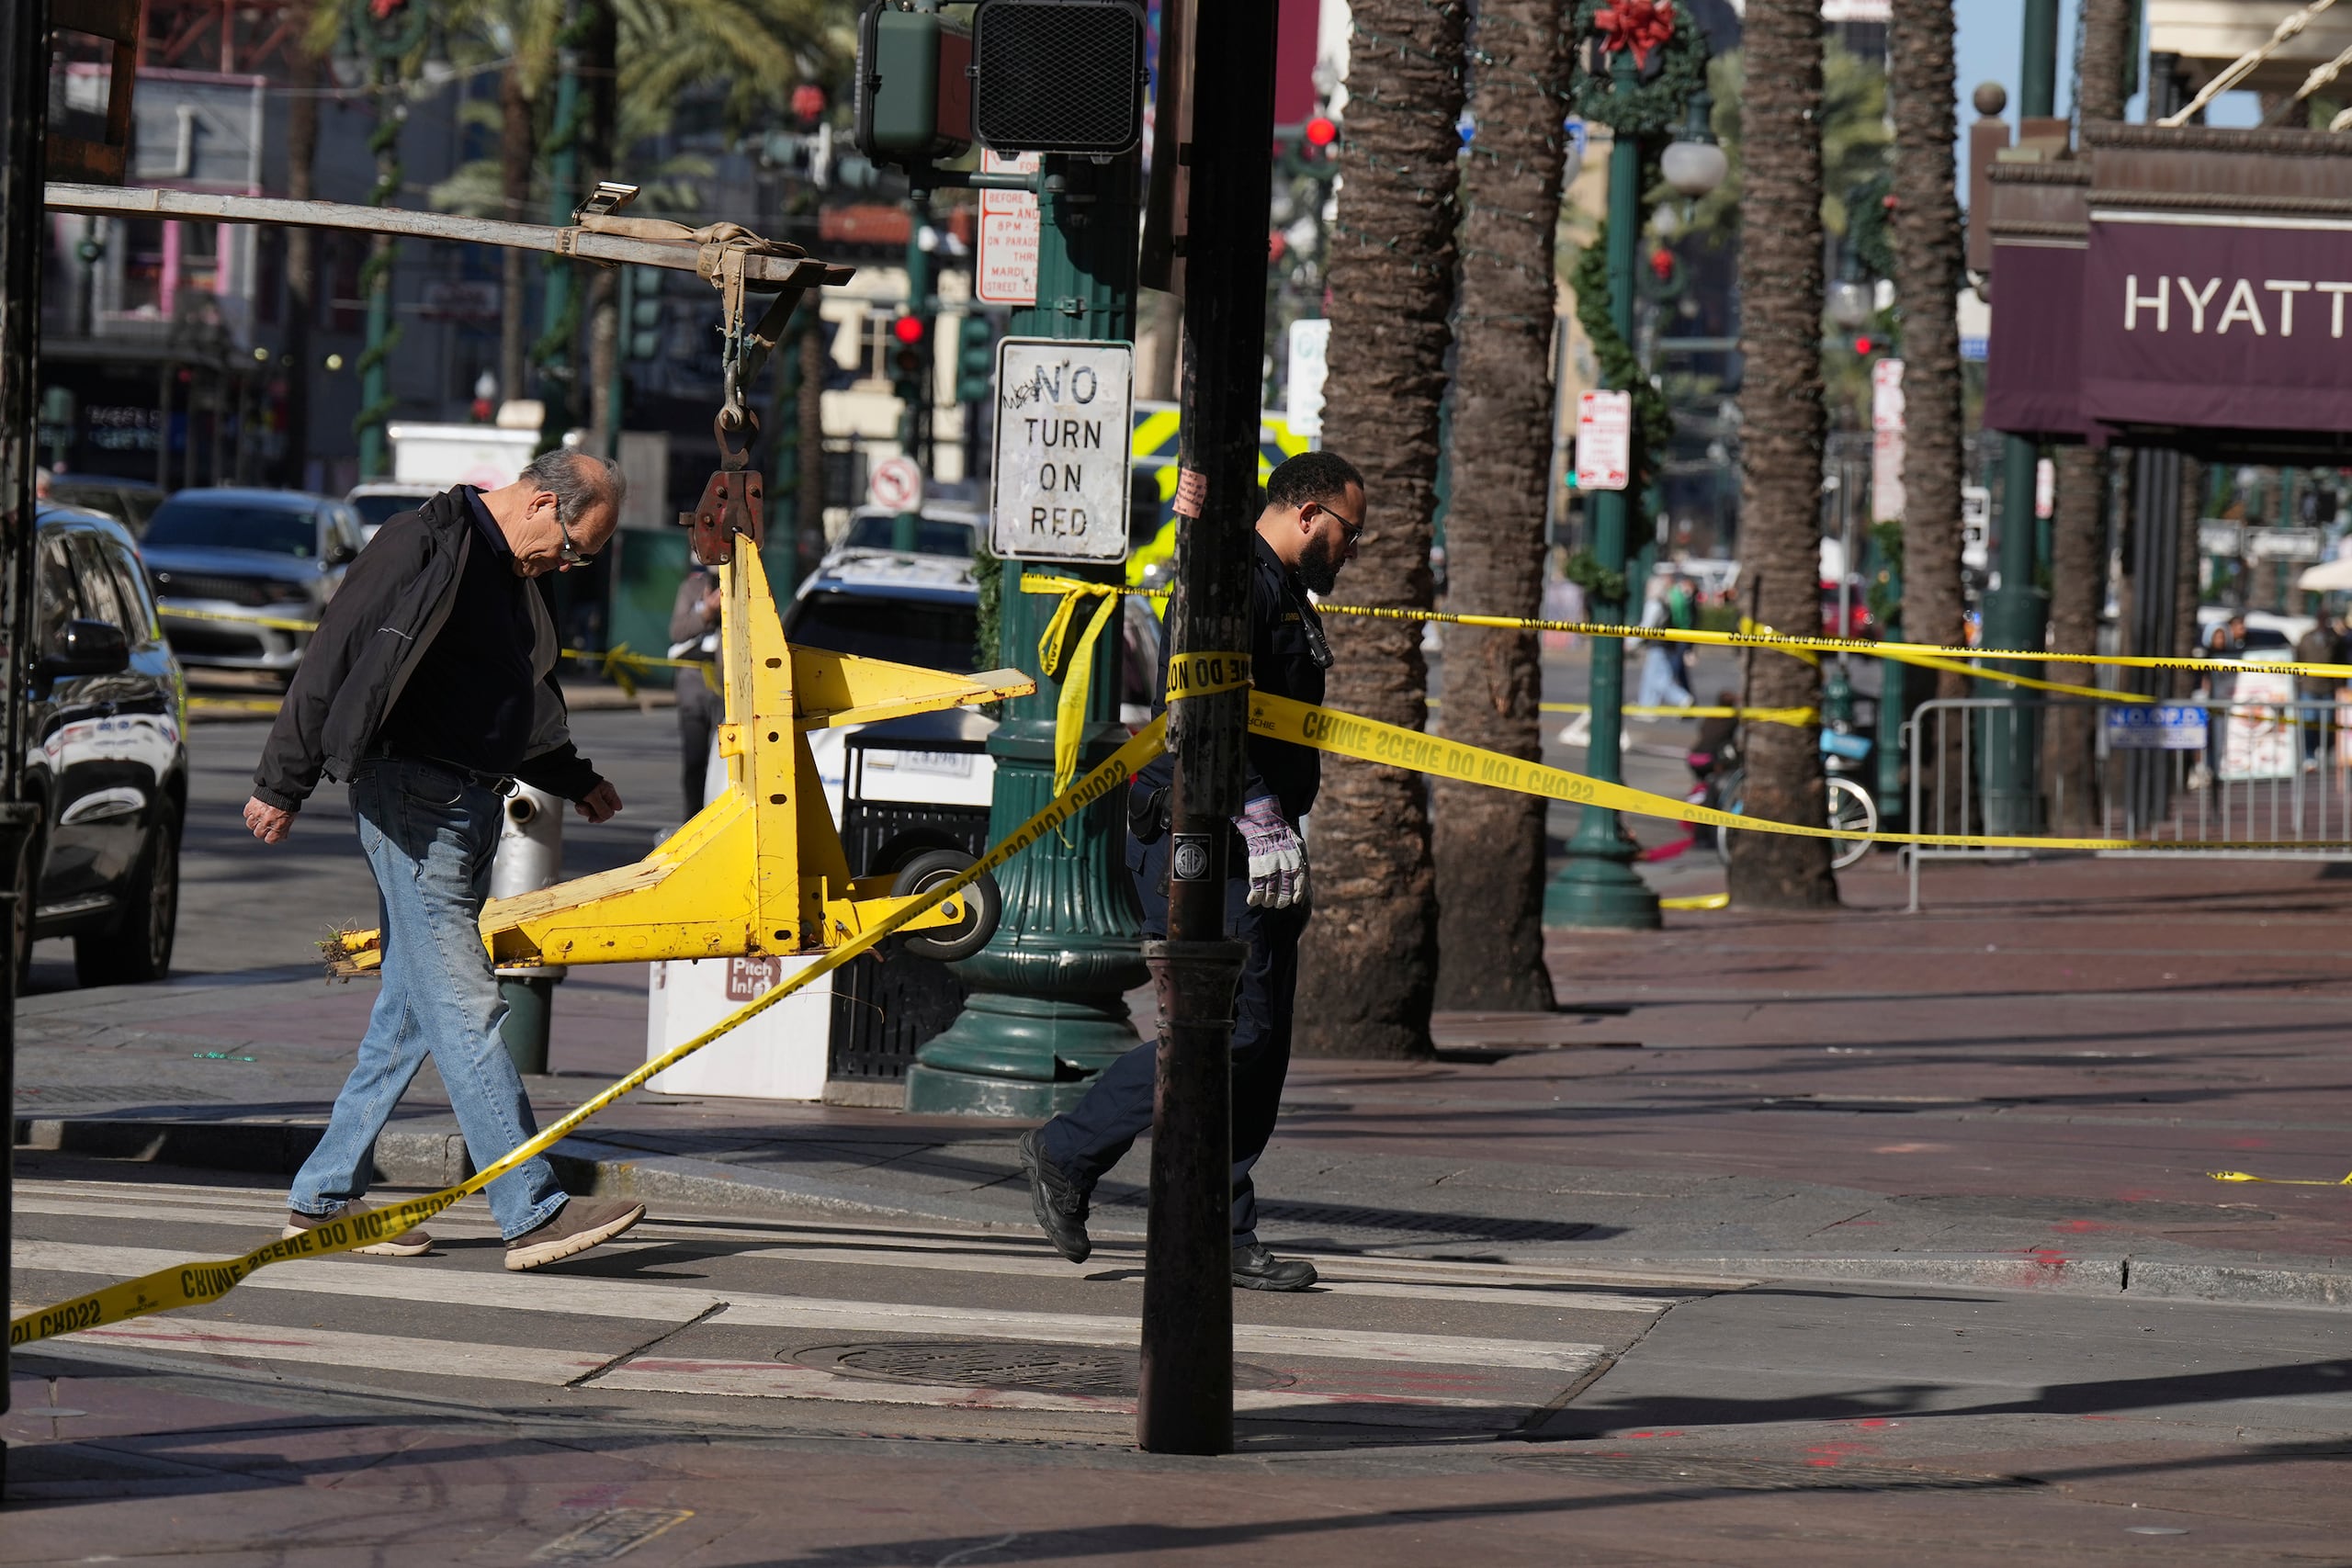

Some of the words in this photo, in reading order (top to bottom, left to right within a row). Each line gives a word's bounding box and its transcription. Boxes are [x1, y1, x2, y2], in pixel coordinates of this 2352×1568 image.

[989, 192, 1024, 204] BEFORE
[1017, 208, 1039, 220] AND
[987, 235, 1000, 246] ON
[990, 266, 1024, 277] MARDI
[2124, 274, 2352, 339] HYATT
[1034, 364, 1098, 404] NO
[1024, 418, 1102, 449] TURN
[1039, 462, 1081, 492] ON
[1031, 506, 1087, 537] RED
[1195, 658, 1224, 688] DO
[733, 957, 773, 976] Pitch
[731, 976, 753, 995] In!
